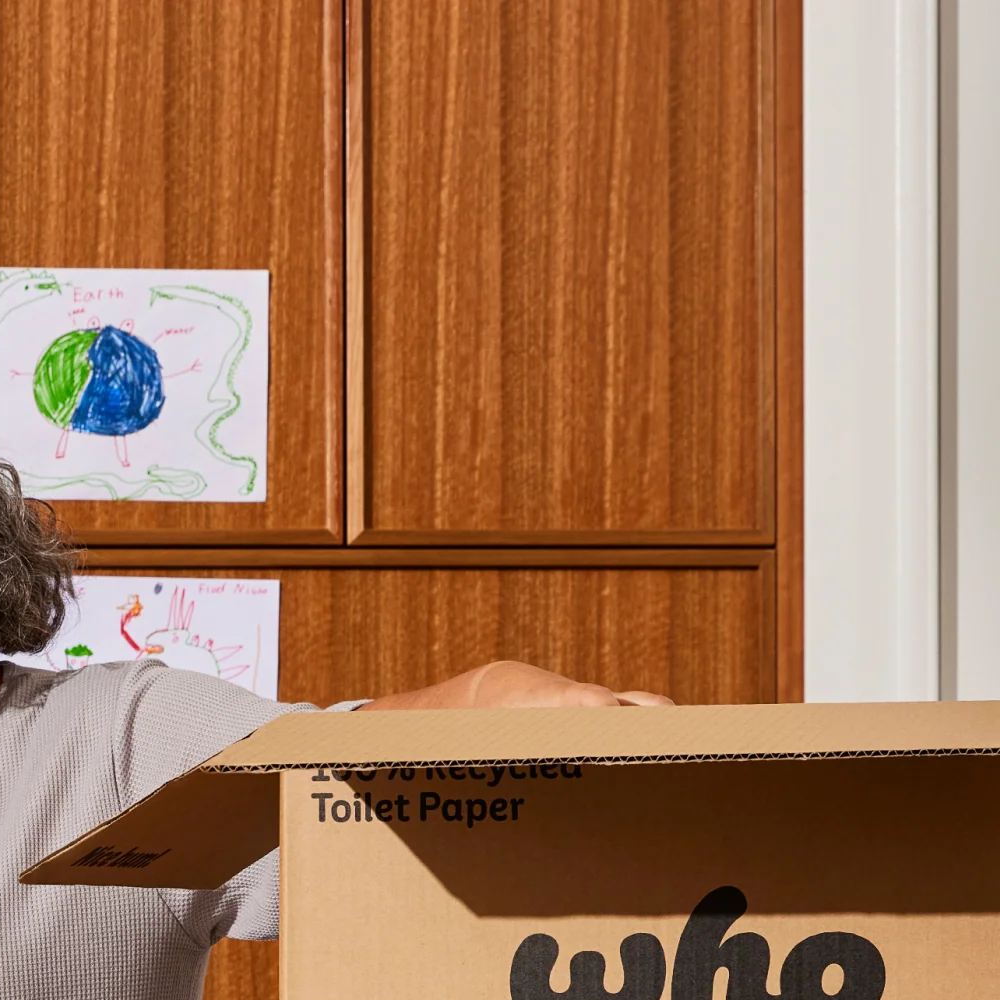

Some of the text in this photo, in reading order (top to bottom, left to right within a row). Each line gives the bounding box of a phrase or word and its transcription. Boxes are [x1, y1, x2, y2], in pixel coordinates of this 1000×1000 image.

[73, 287, 124, 302] Earth
[311, 791, 525, 829] Toilet Paper
